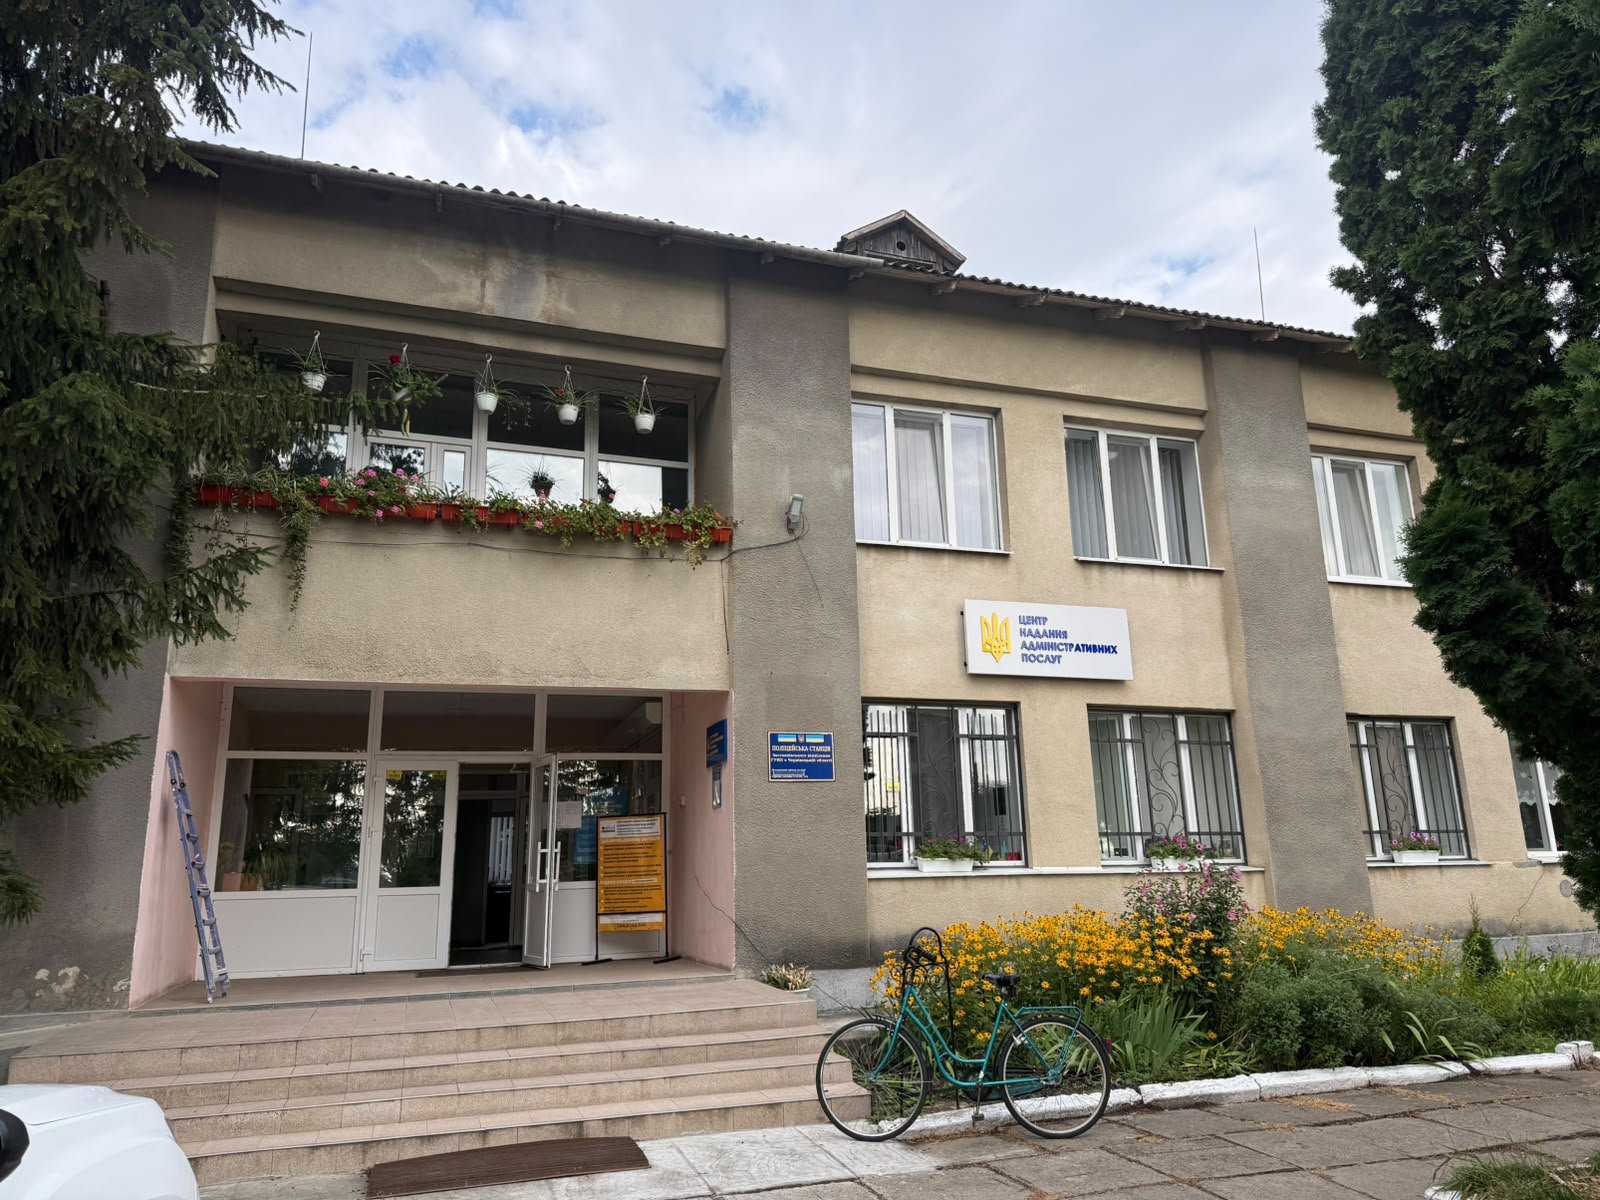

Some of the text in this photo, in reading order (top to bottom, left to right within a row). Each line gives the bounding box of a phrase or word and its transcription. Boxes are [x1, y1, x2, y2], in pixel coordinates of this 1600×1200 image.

[1018, 615, 1048, 626] ЦЕНТР
[1019, 628, 1068, 639] НАДАННЯ
[1020, 641, 1118, 654] АДМІНІСТРАТИВНИХ
[1021, 653, 1062, 664] ПОСЛУГ
